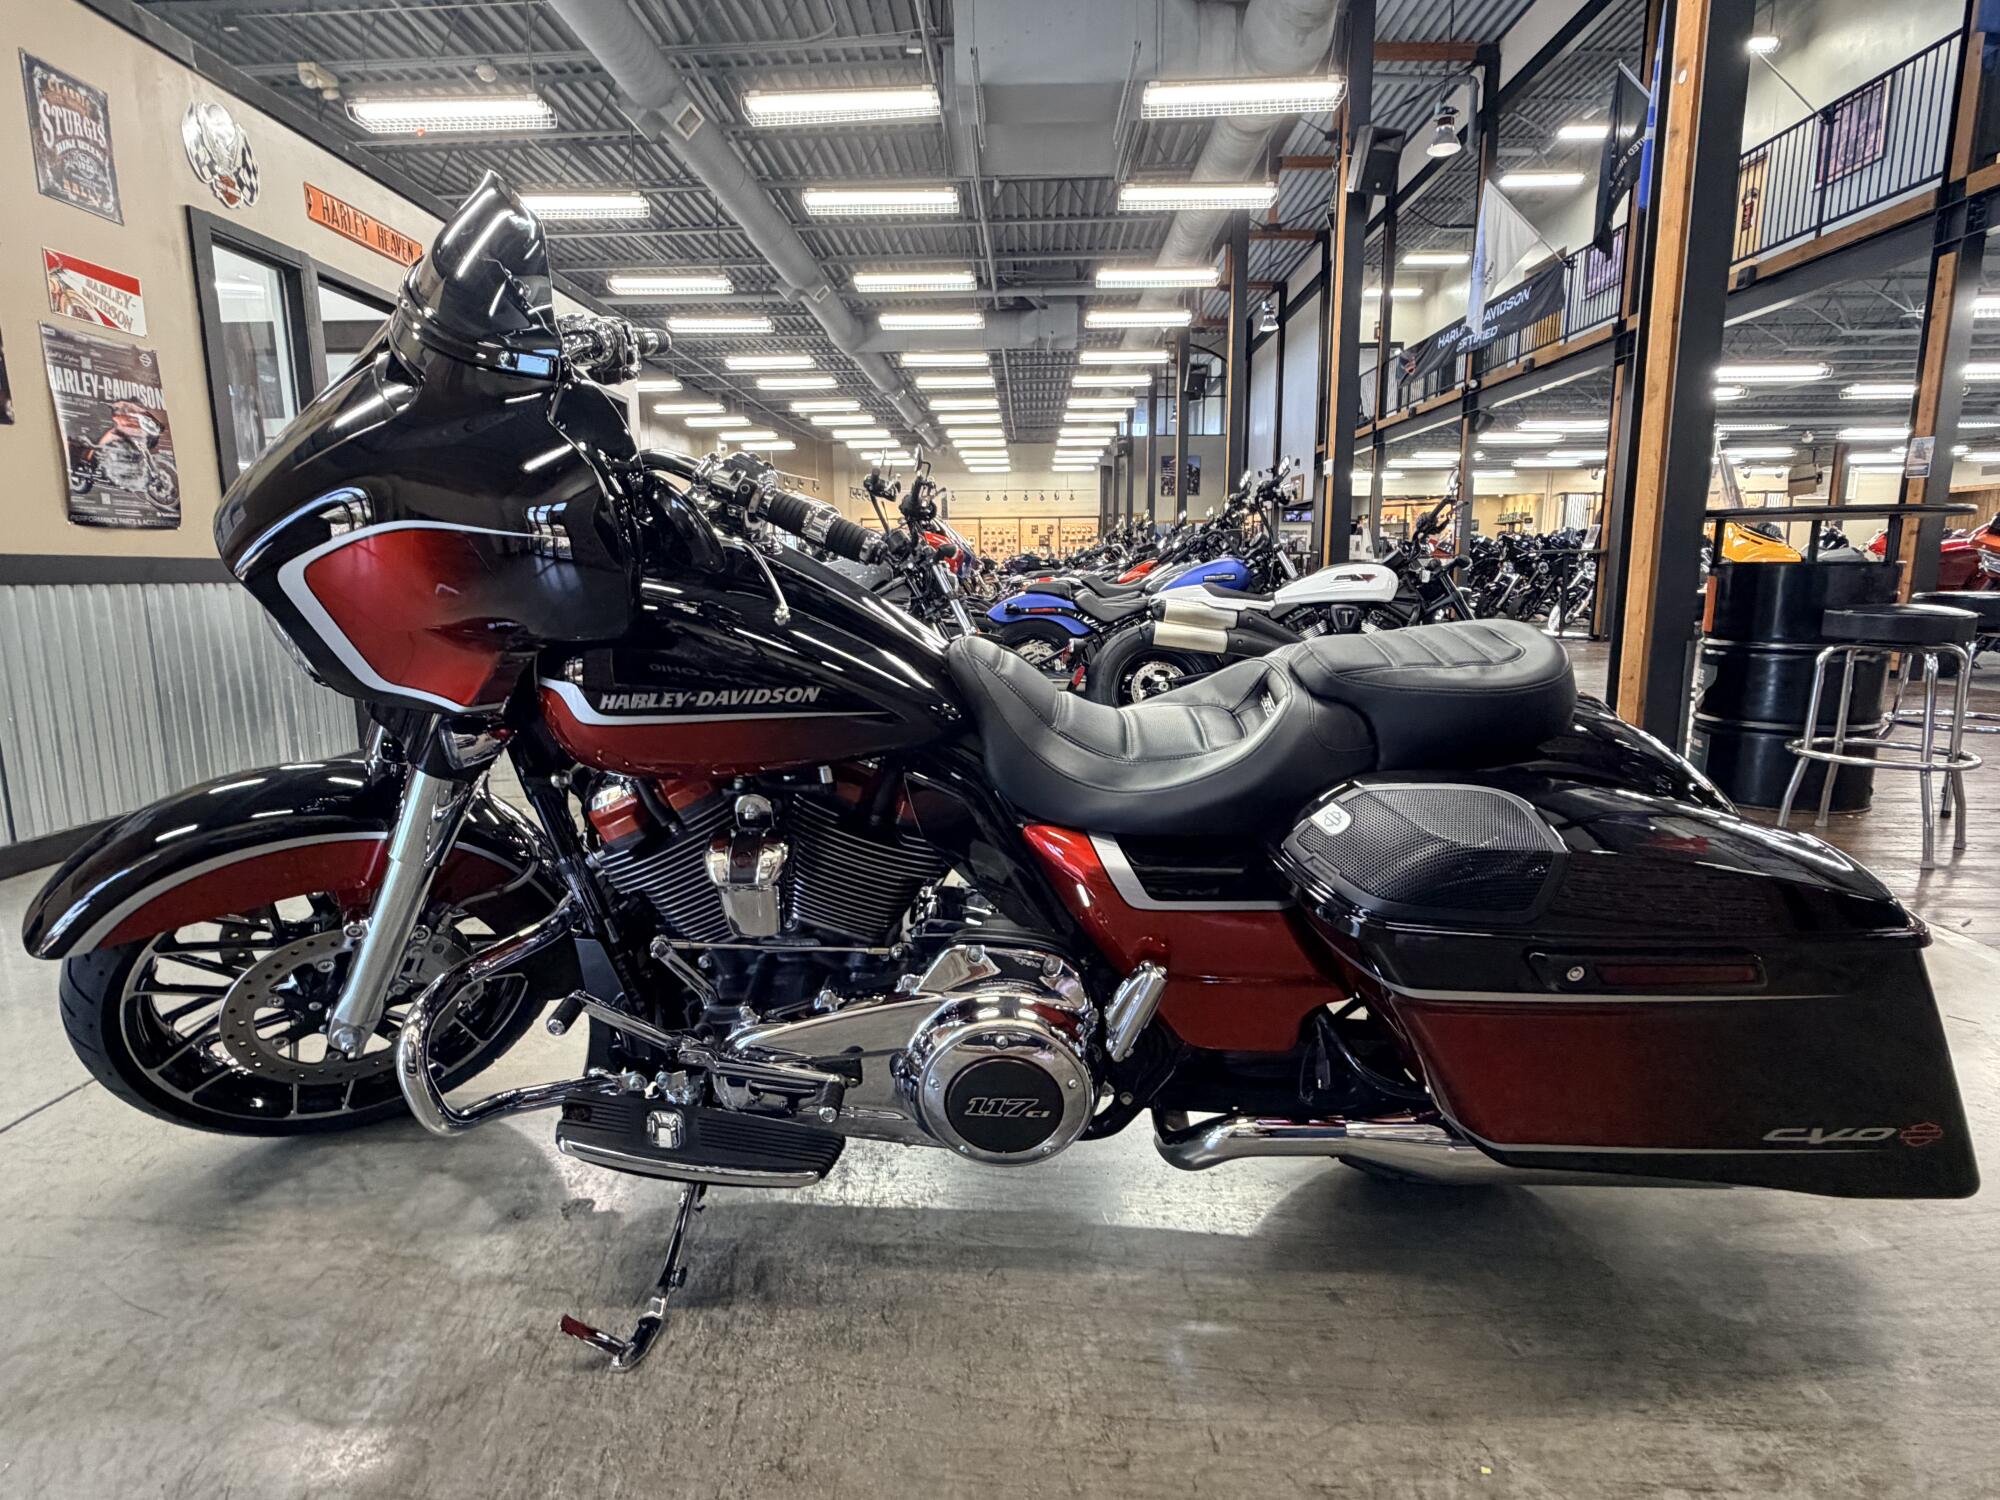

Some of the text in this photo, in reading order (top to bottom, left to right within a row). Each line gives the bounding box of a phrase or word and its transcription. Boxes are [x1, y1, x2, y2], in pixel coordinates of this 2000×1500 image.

[39, 98, 107, 149] STURGIS
[321, 194, 414, 264] HARLEY HEAVEN
[81, 286, 133, 331] DAVIDSON
[46, 364, 167, 411] HARLEY-DAVIDSON
[1341, 610, 1353, 626] T
[600, 687, 821, 710] HARLEY-DAVIDSON
[1762, 1127, 1897, 1145] CVO
